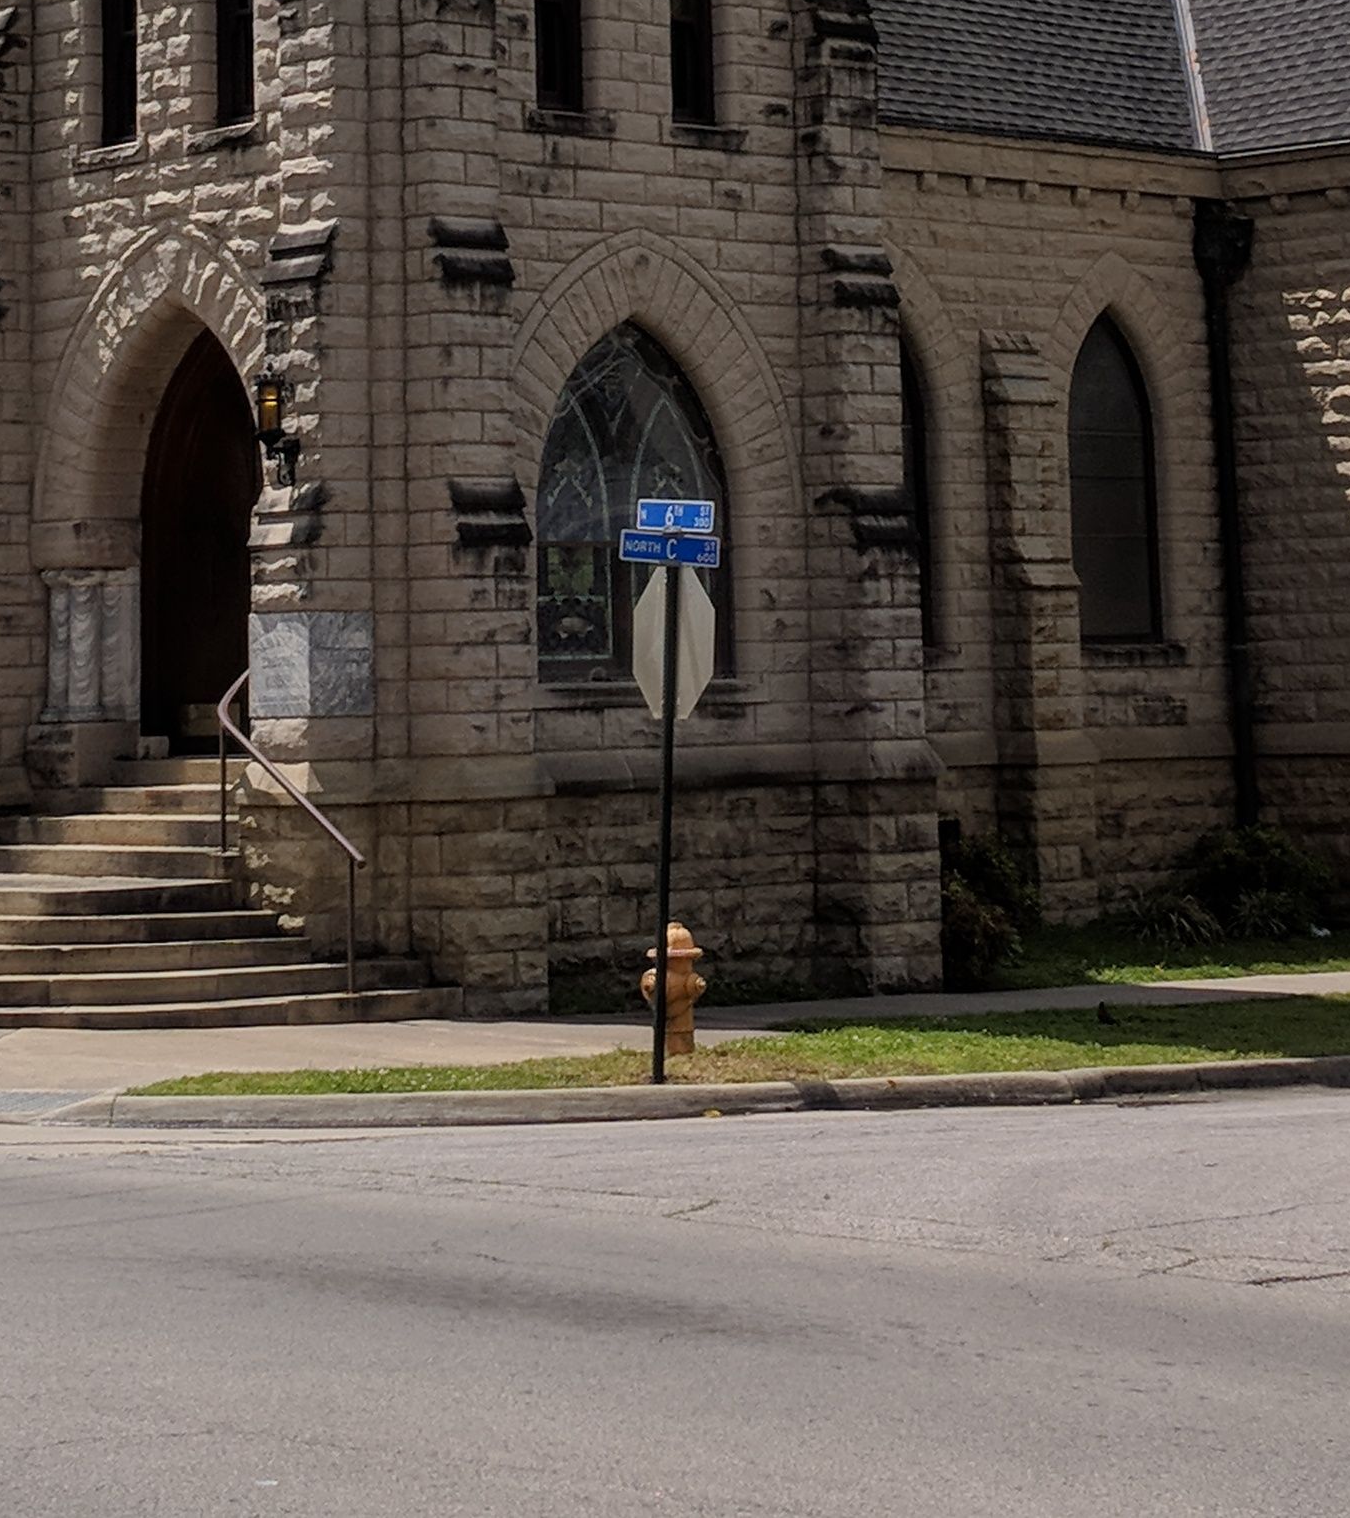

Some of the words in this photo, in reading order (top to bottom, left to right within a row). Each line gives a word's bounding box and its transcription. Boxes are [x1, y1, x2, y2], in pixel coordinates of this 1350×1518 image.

[700, 506, 710, 517] ST
[624, 540, 661, 553] NORTH
[666, 538, 678, 560] C
[704, 541, 716, 552] ST
